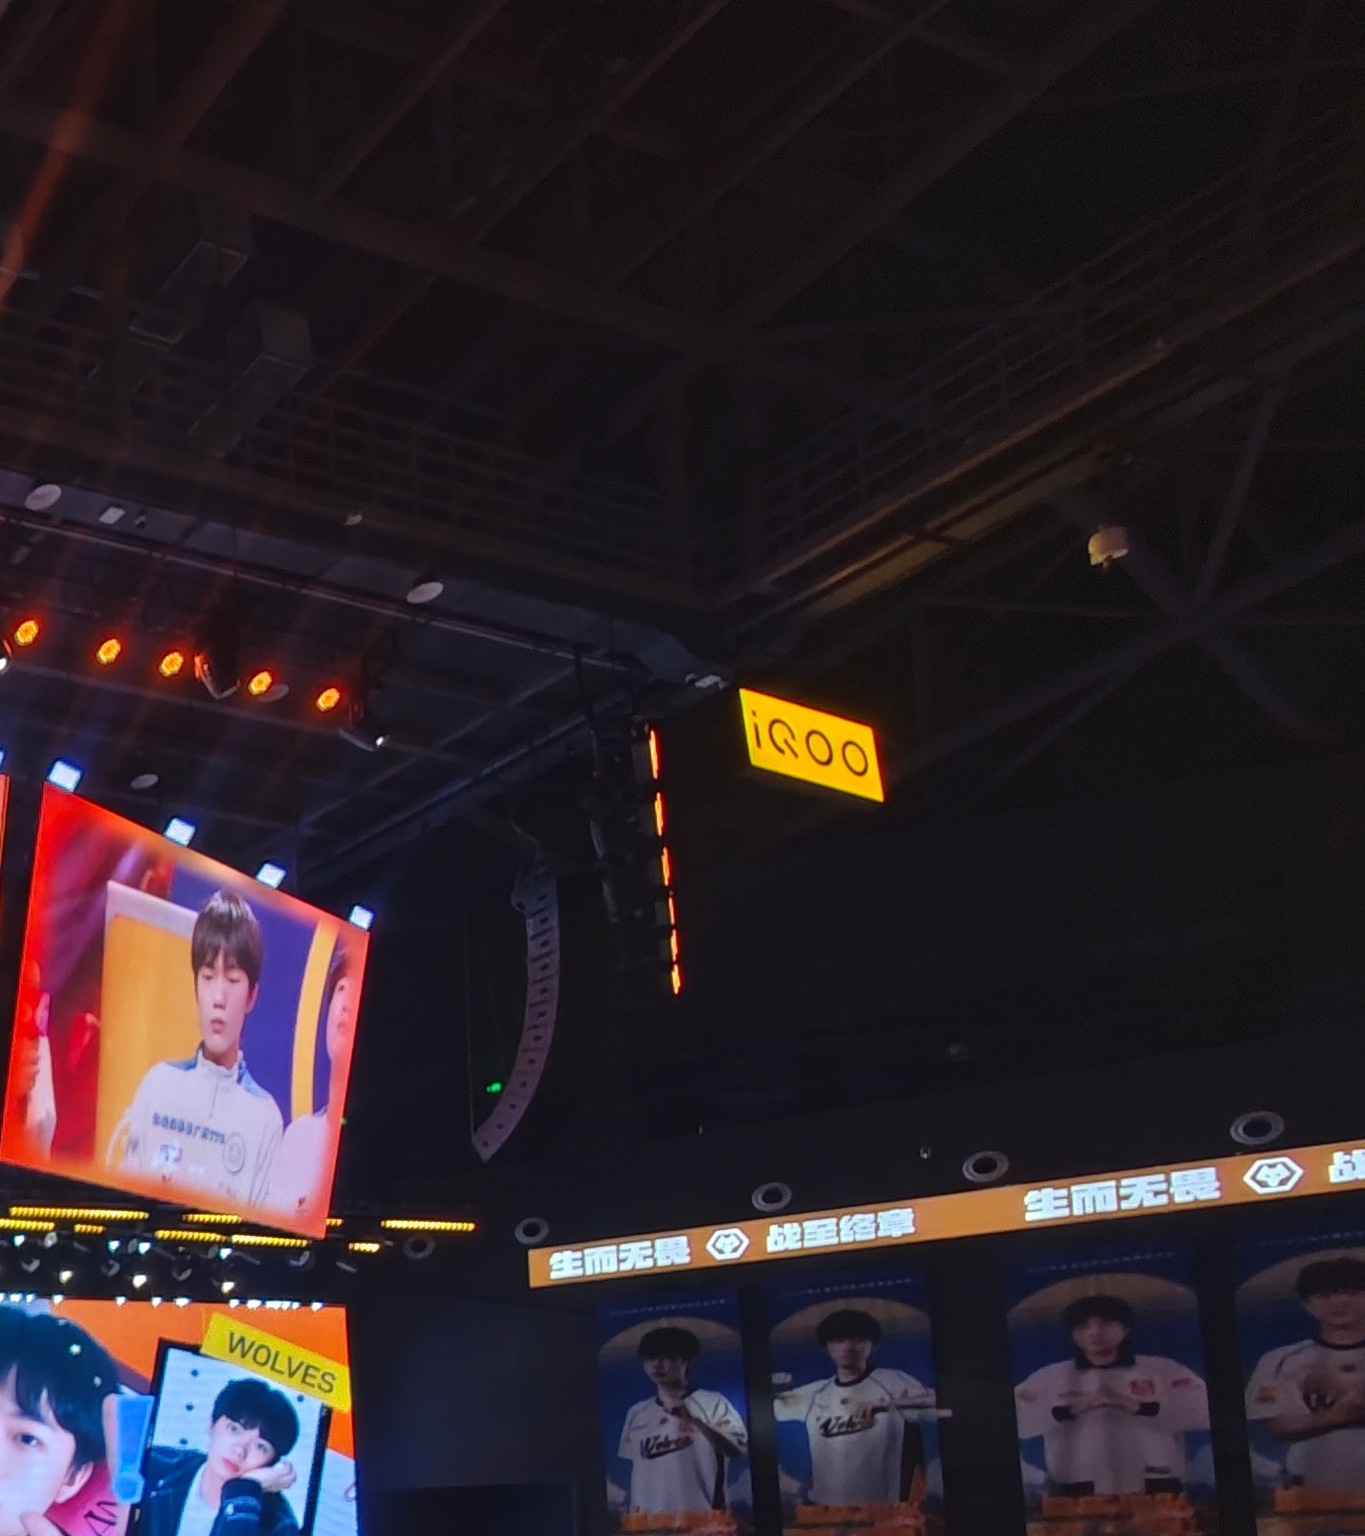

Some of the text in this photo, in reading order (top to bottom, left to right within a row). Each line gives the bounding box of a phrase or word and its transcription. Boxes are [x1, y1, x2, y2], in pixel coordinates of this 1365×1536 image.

[1024, 1166, 1222, 1222] 生而无畏
[766, 1208, 916, 1254] 战至终章
[549, 1235, 692, 1280] 生而无畏
[228, 1331, 337, 1393] WOLVES
